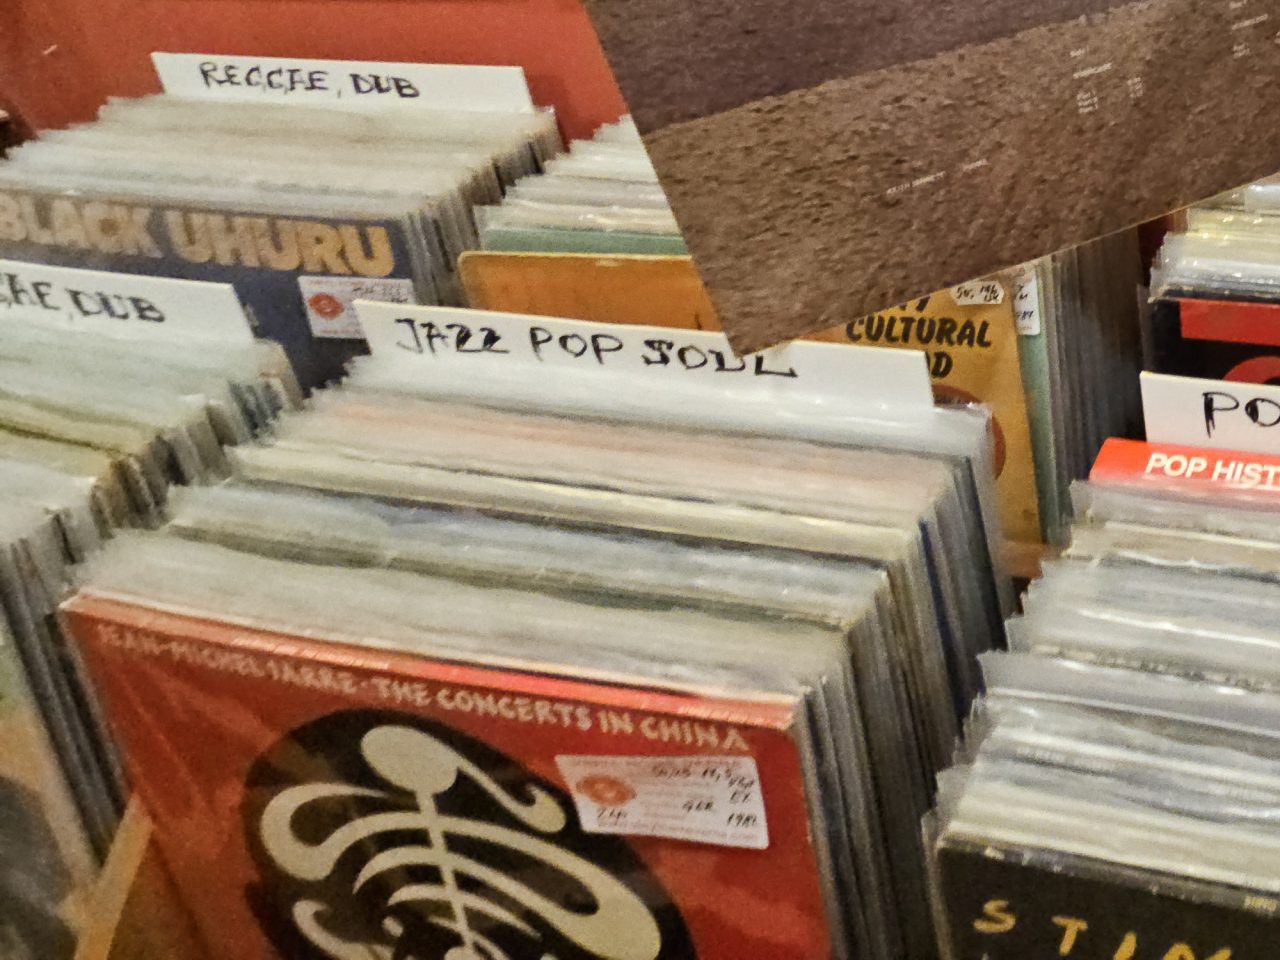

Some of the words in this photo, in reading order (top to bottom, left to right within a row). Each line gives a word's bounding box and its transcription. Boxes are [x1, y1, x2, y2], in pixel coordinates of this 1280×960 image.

[350, 73, 420, 98] DUB
[0, 190, 163, 259] BLACK
[164, 208, 395, 279] UHURU
[65, 287, 166, 323] DUB
[395, 319, 509, 355] JAZZ
[529, 325, 623, 365] POP
[846, 315, 992, 349] CULTURAL
[1145, 452, 1208, 478] POP
[373, 677, 431, 707] THE
[435, 688, 593, 731] CONCERTS
[598, 710, 634, 737] IN
[641, 716, 750, 752] CHINA
